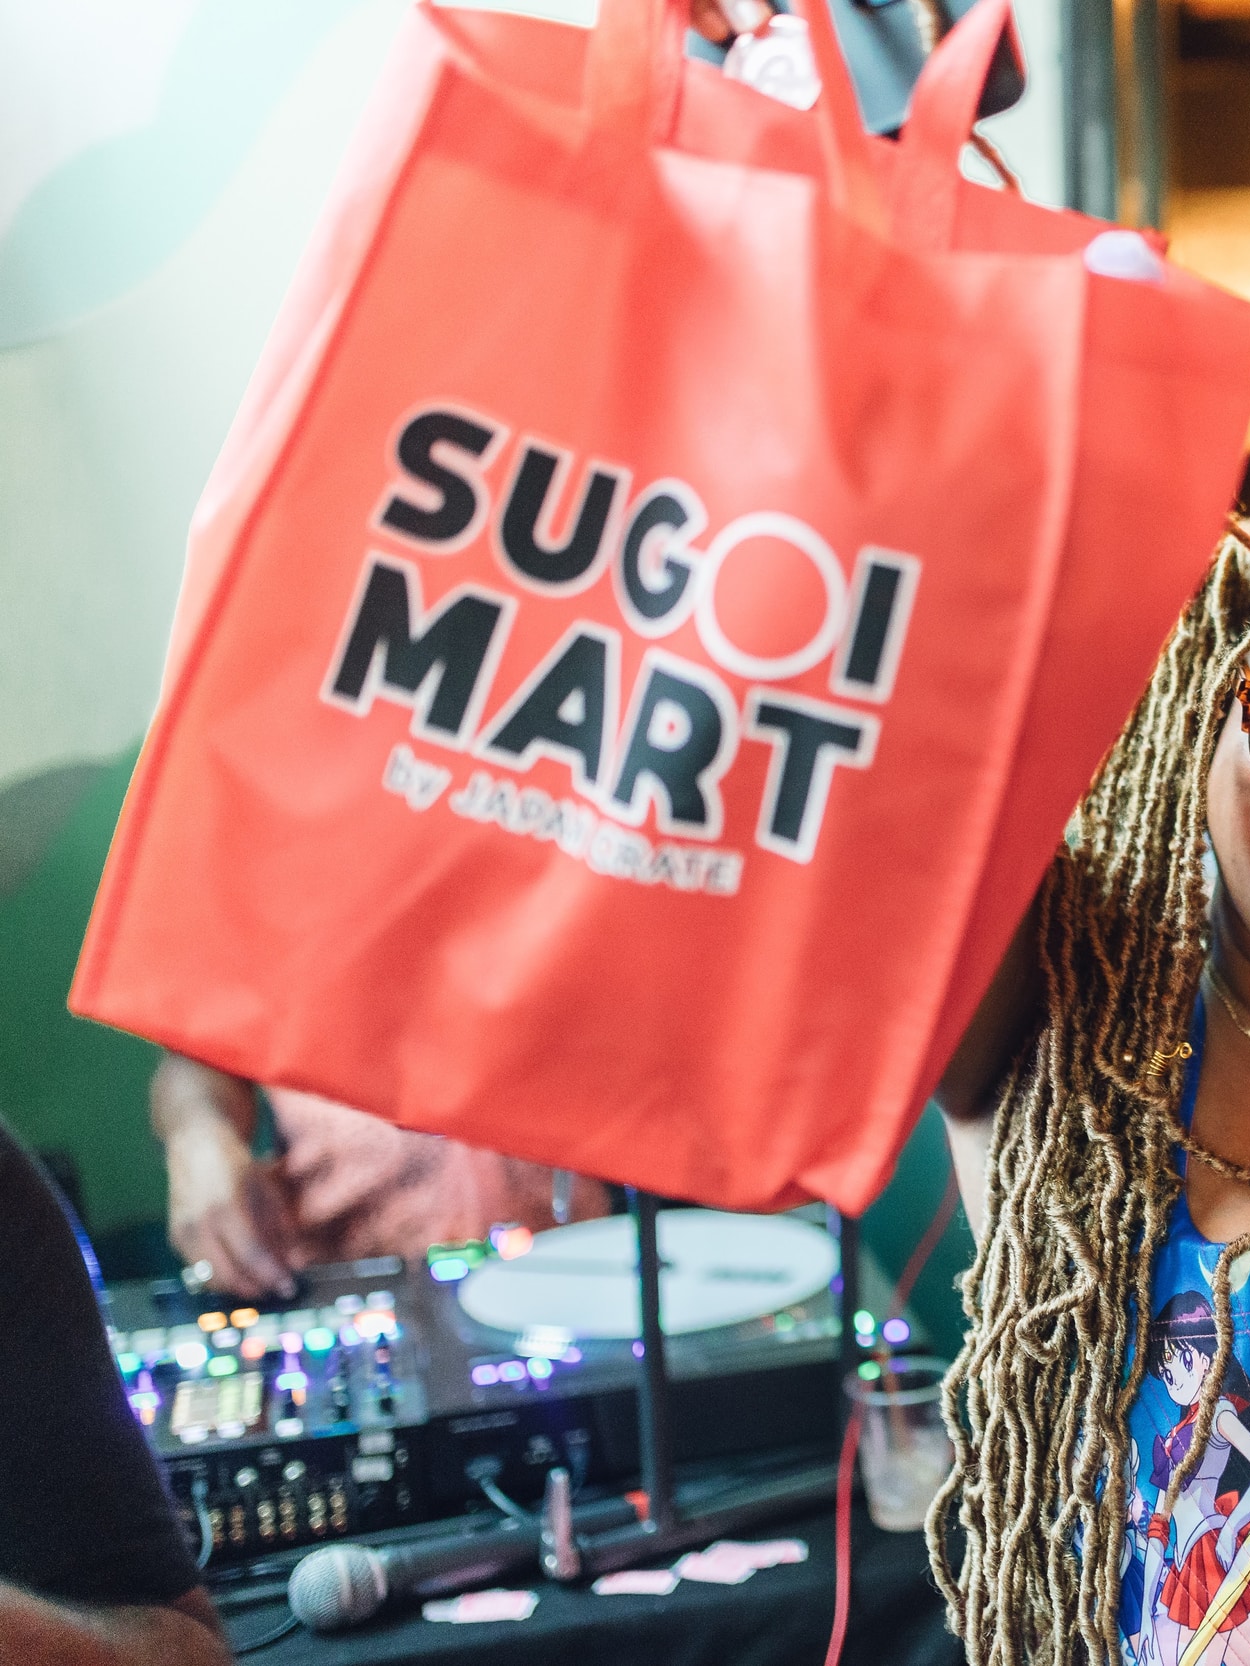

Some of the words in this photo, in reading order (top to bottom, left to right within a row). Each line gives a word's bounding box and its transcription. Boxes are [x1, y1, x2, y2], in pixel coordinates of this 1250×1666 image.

[370, 402, 922, 705] SUGOI
[320, 548, 880, 865] MART
[382, 743, 452, 812] by
